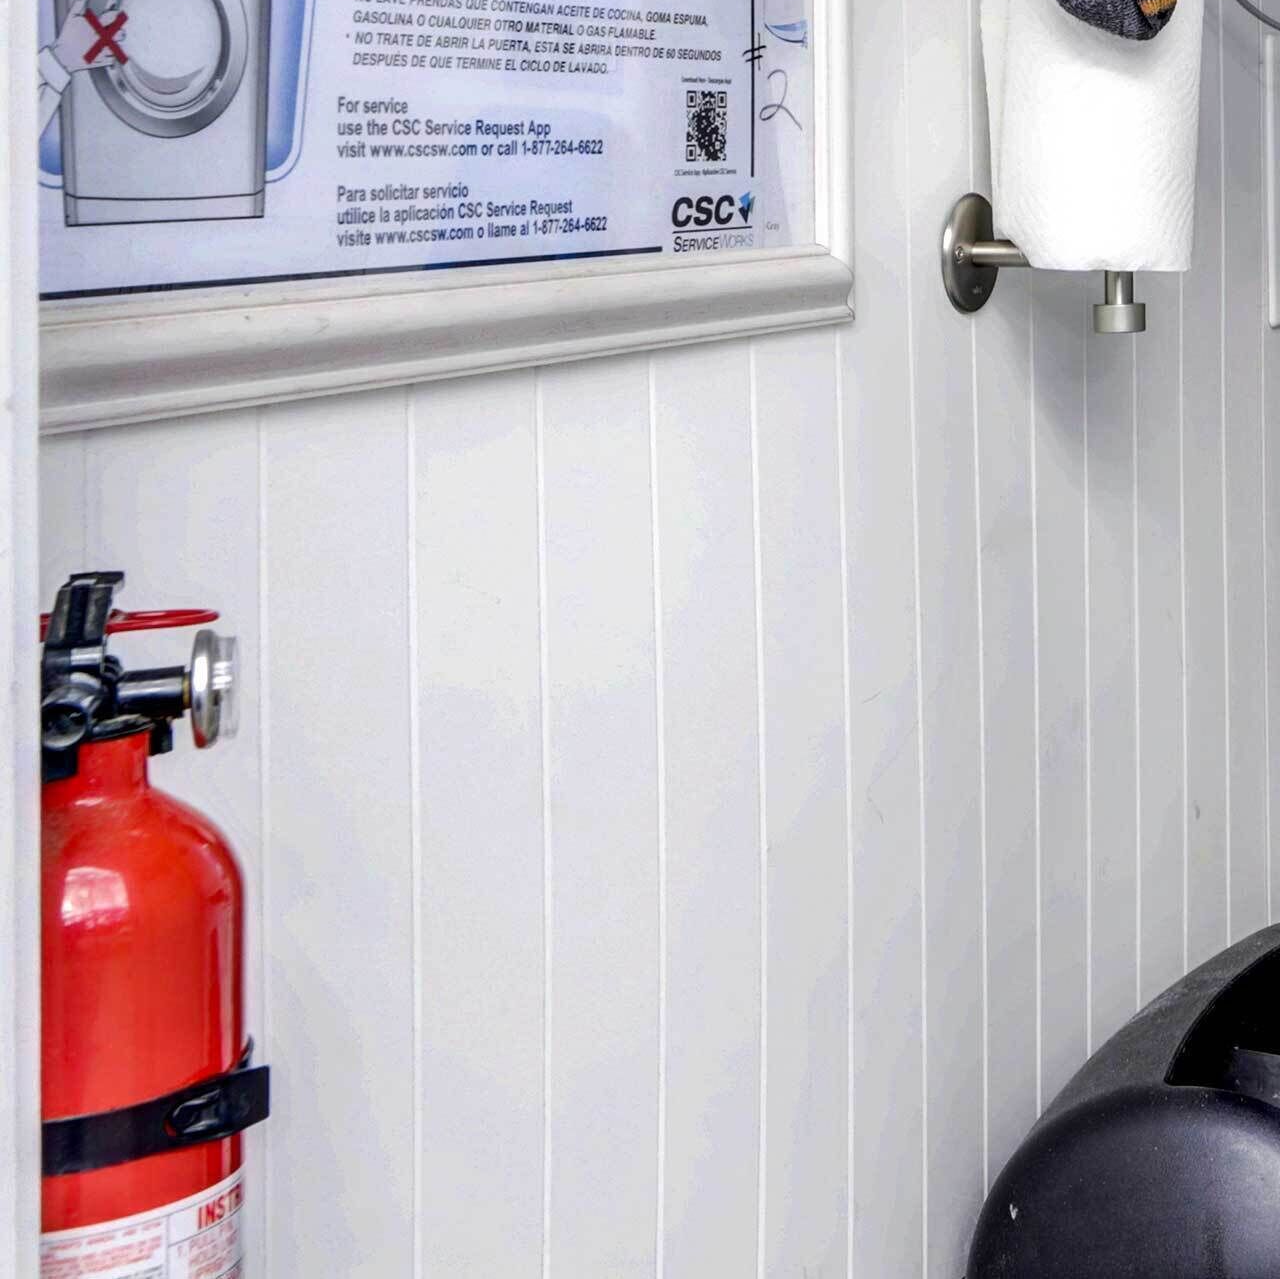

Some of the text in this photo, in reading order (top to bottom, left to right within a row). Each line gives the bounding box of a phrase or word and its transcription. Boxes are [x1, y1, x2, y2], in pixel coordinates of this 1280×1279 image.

[337, 95, 408, 114] For service
[337, 139, 603, 157] visit www.cscsw.com or call 1-877-264-6622
[671, 194, 735, 227] CSC
